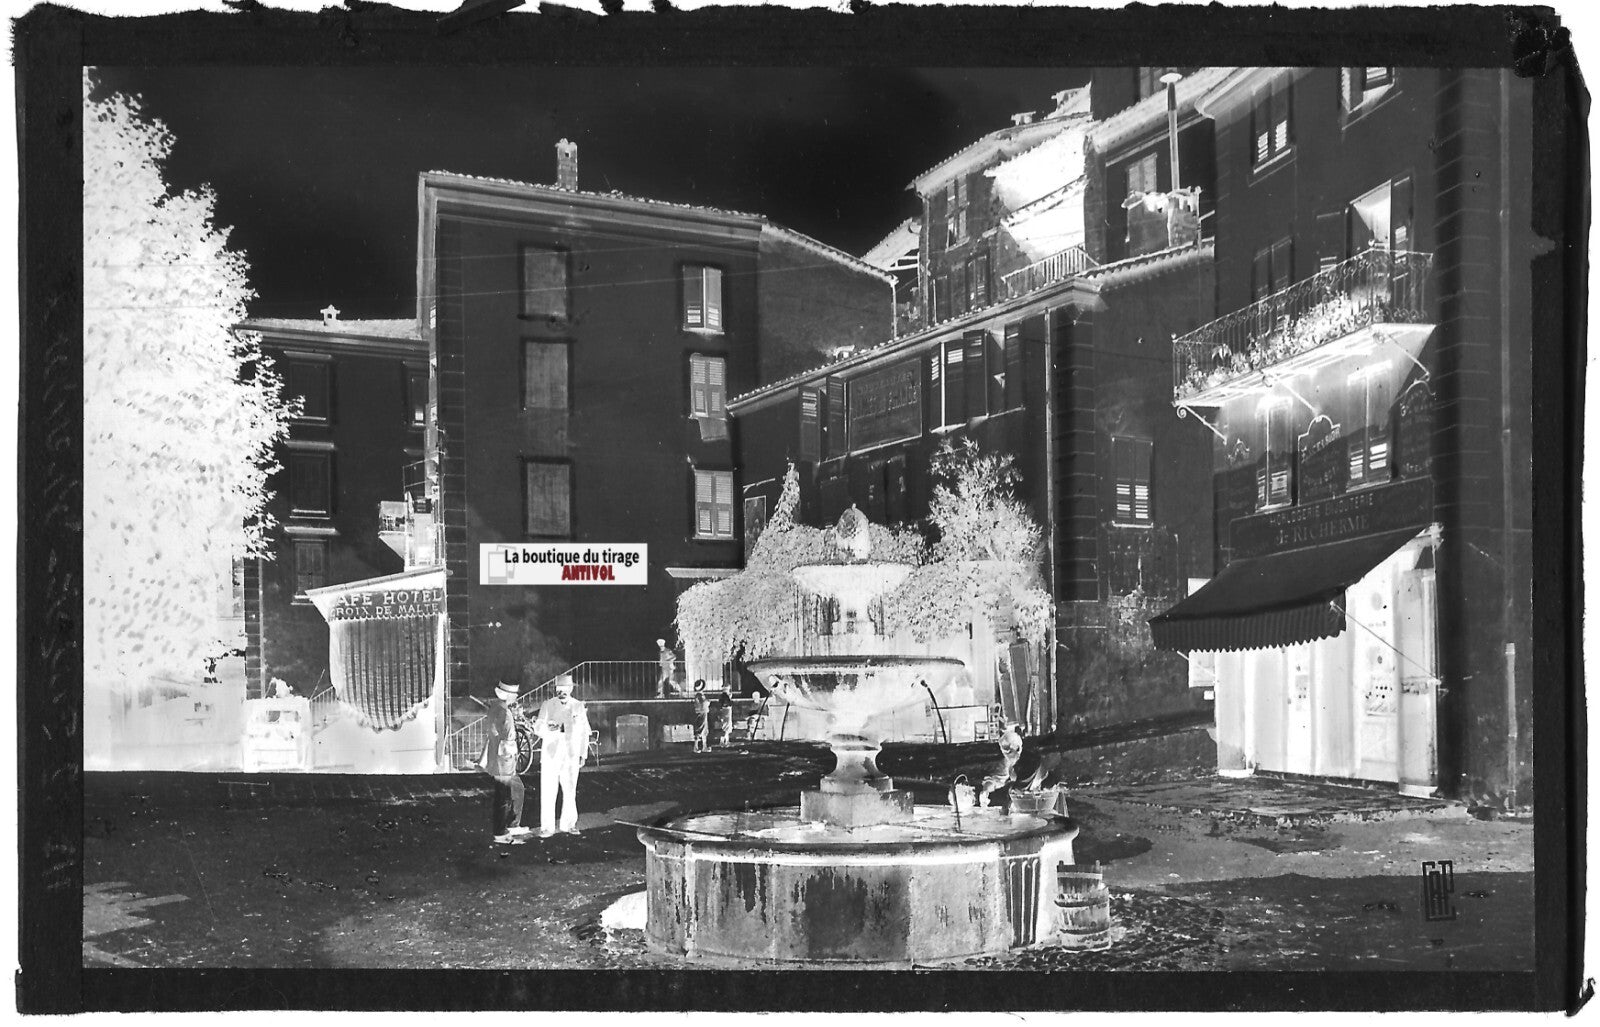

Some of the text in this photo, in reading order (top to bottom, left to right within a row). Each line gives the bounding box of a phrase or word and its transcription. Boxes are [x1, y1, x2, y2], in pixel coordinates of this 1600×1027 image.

[334, 590, 442, 607] AFE HOTEL
[376, 605, 392, 615] DE
[399, 603, 438, 614] MALTE
